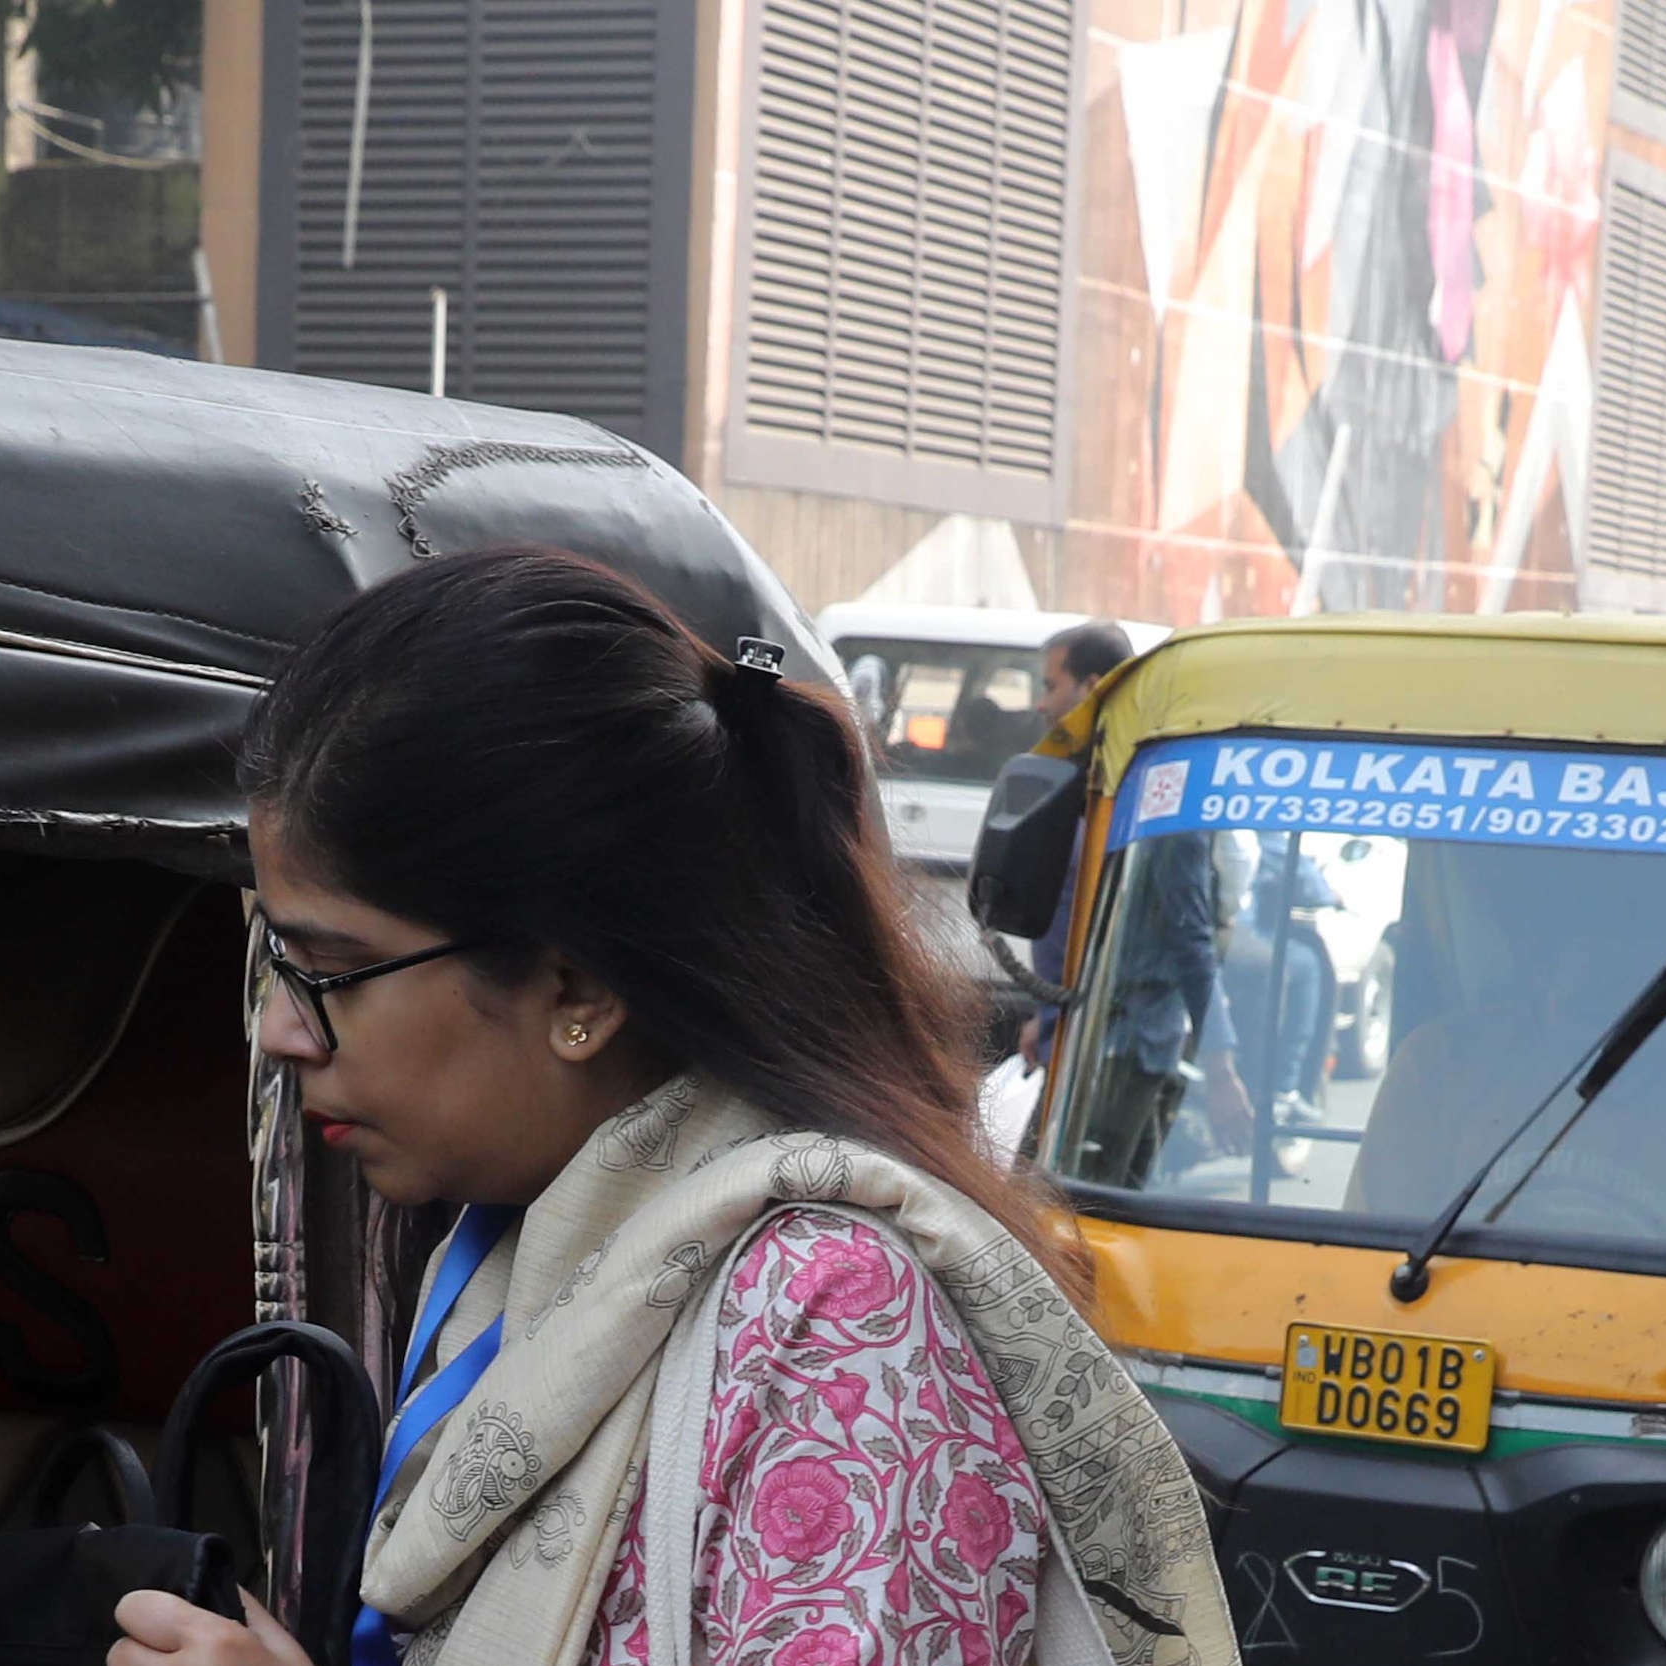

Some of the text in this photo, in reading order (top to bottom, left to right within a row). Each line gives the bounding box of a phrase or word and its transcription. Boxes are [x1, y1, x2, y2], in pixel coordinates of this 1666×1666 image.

[1210, 746, 1535, 800] KOLKATA
[1323, 1333, 1465, 1391] WB01B
[1317, 1381, 1461, 1439] D0669
[1315, 1565, 1398, 1601] RE
